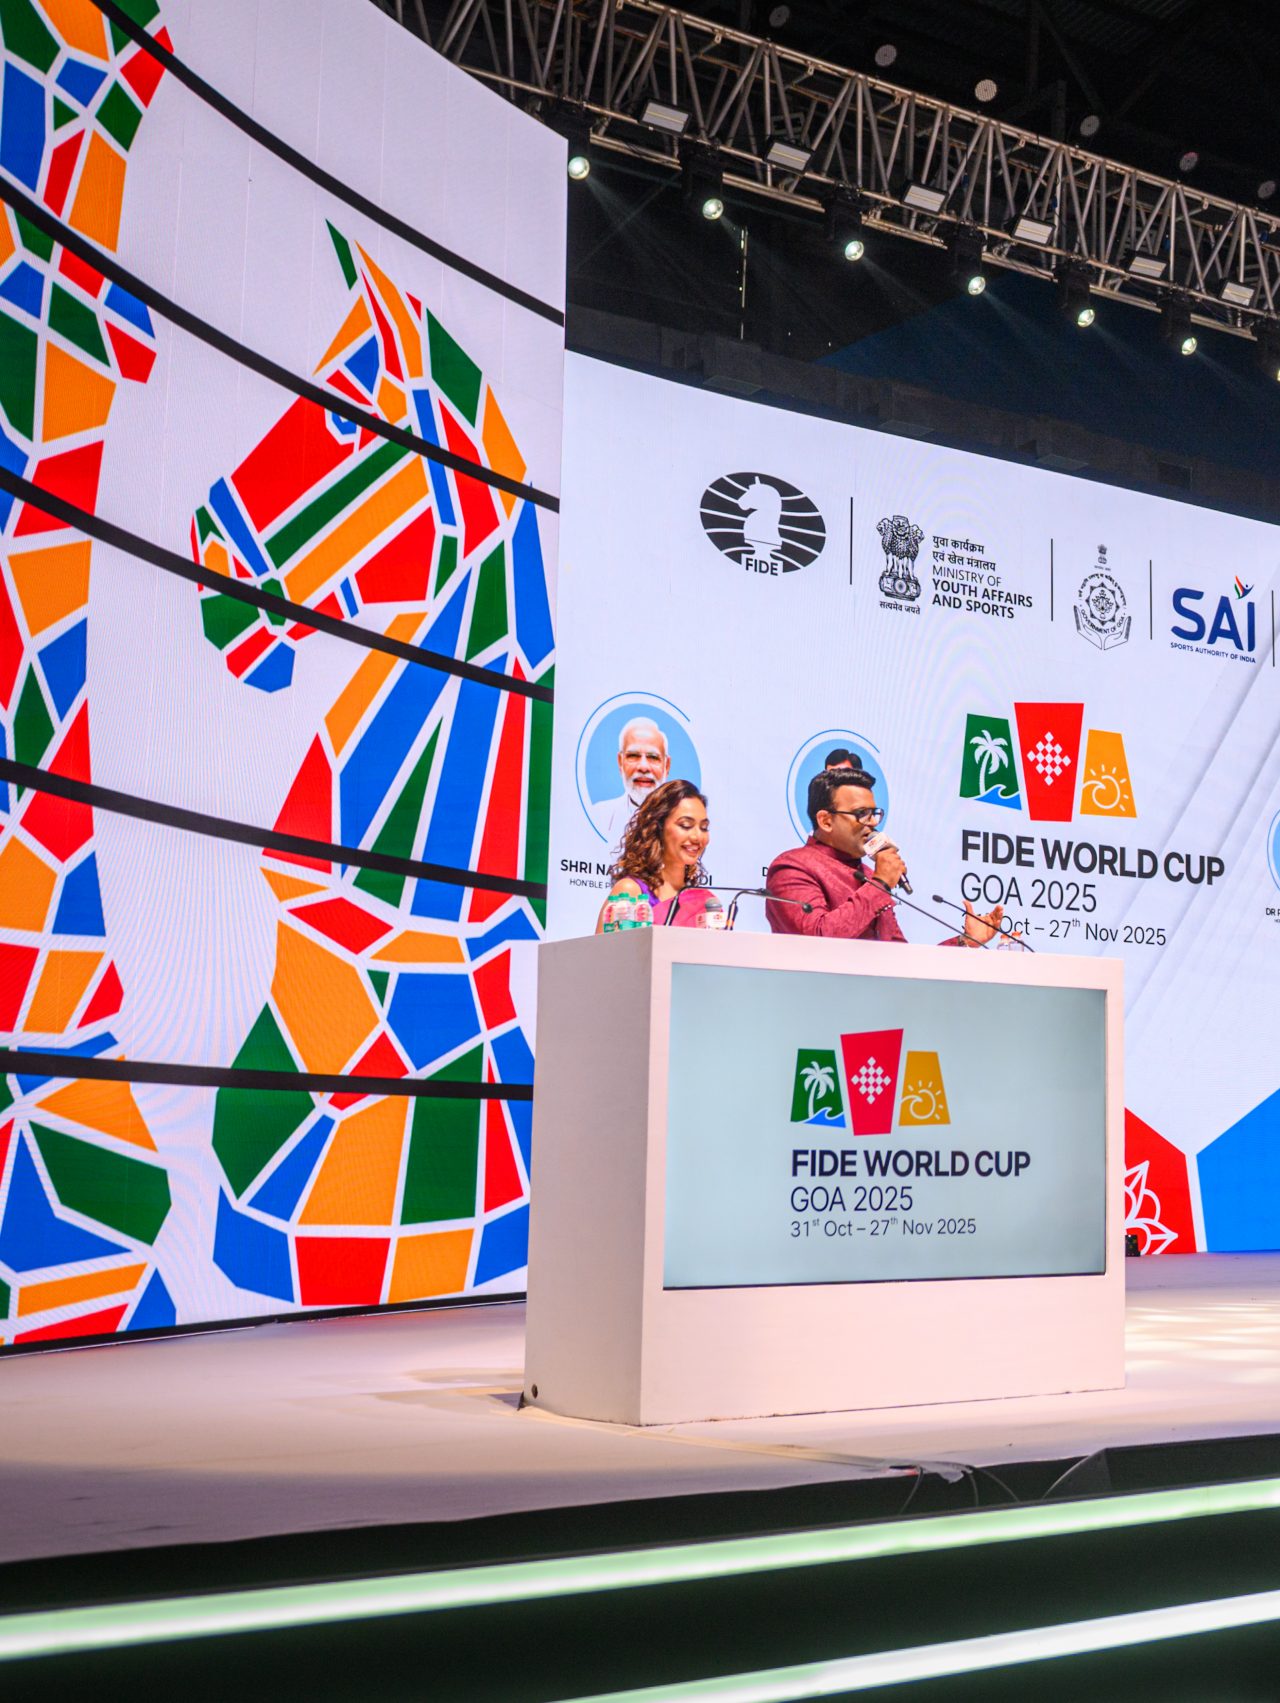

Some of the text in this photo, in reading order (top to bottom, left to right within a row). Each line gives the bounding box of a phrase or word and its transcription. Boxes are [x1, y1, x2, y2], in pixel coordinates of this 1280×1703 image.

[933, 536, 984, 554] युवा कार्यक्रम
[746, 558, 778, 576] FIDE
[932, 551, 996, 571] एवं खेल मंत्रालय
[933, 565, 1001, 587] MINISTRY OF
[933, 578, 1032, 607] YOUTH AFFAIRS
[932, 594, 1014, 618] AND SPORTS
[1171, 587, 1256, 652] SAI
[1171, 642, 1193, 652] SPORTS
[1195, 648, 1228, 658] AUTHORITY
[560, 859, 592, 874] SHRI
[962, 829, 1225, 886] FIDE WORLD CUP
[570, 878, 602, 889] HON'BLE
[961, 872, 1096, 912] GOA 2025
[1266, 908, 1275, 916] DR
[1000, 915, 1030, 936] Oct
[1086, 922, 1118, 942] Nov
[1123, 925, 1166, 946] 2025
[792, 1149, 1031, 1177] FIDE WORLD CUP
[791, 1186, 913, 1212] GOA 2025
[824, 1219, 852, 1236] Oct
[903, 1219, 933, 1235] Nov
[937, 1218, 976, 1235] 2025
